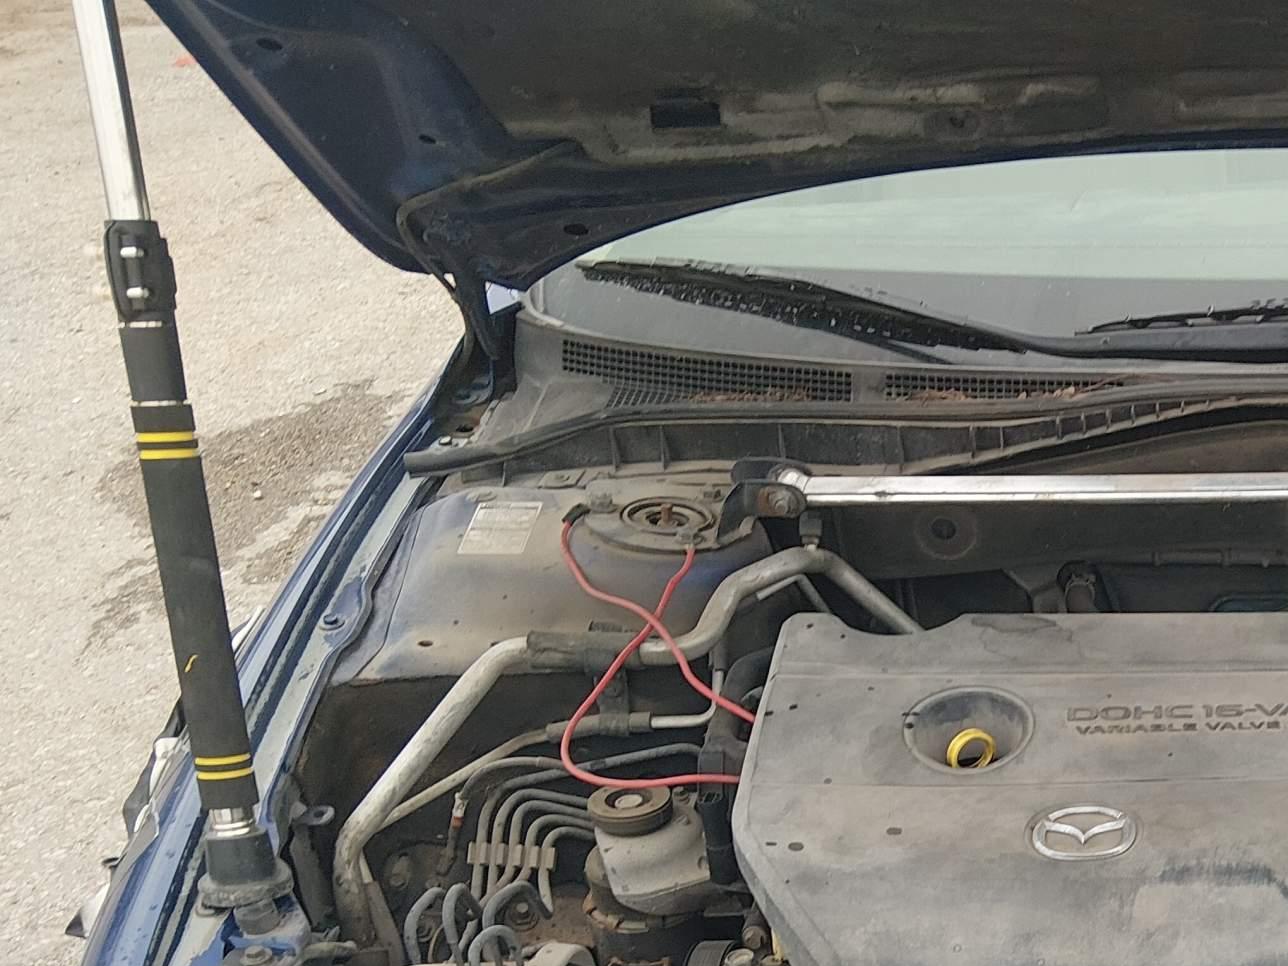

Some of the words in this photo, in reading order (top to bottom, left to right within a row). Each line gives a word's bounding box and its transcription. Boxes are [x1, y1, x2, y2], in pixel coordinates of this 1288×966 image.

[1067, 704, 1194, 722] DOHC
[1075, 723, 1198, 735] VARIABLE
[1205, 720, 1281, 731] VALVE
